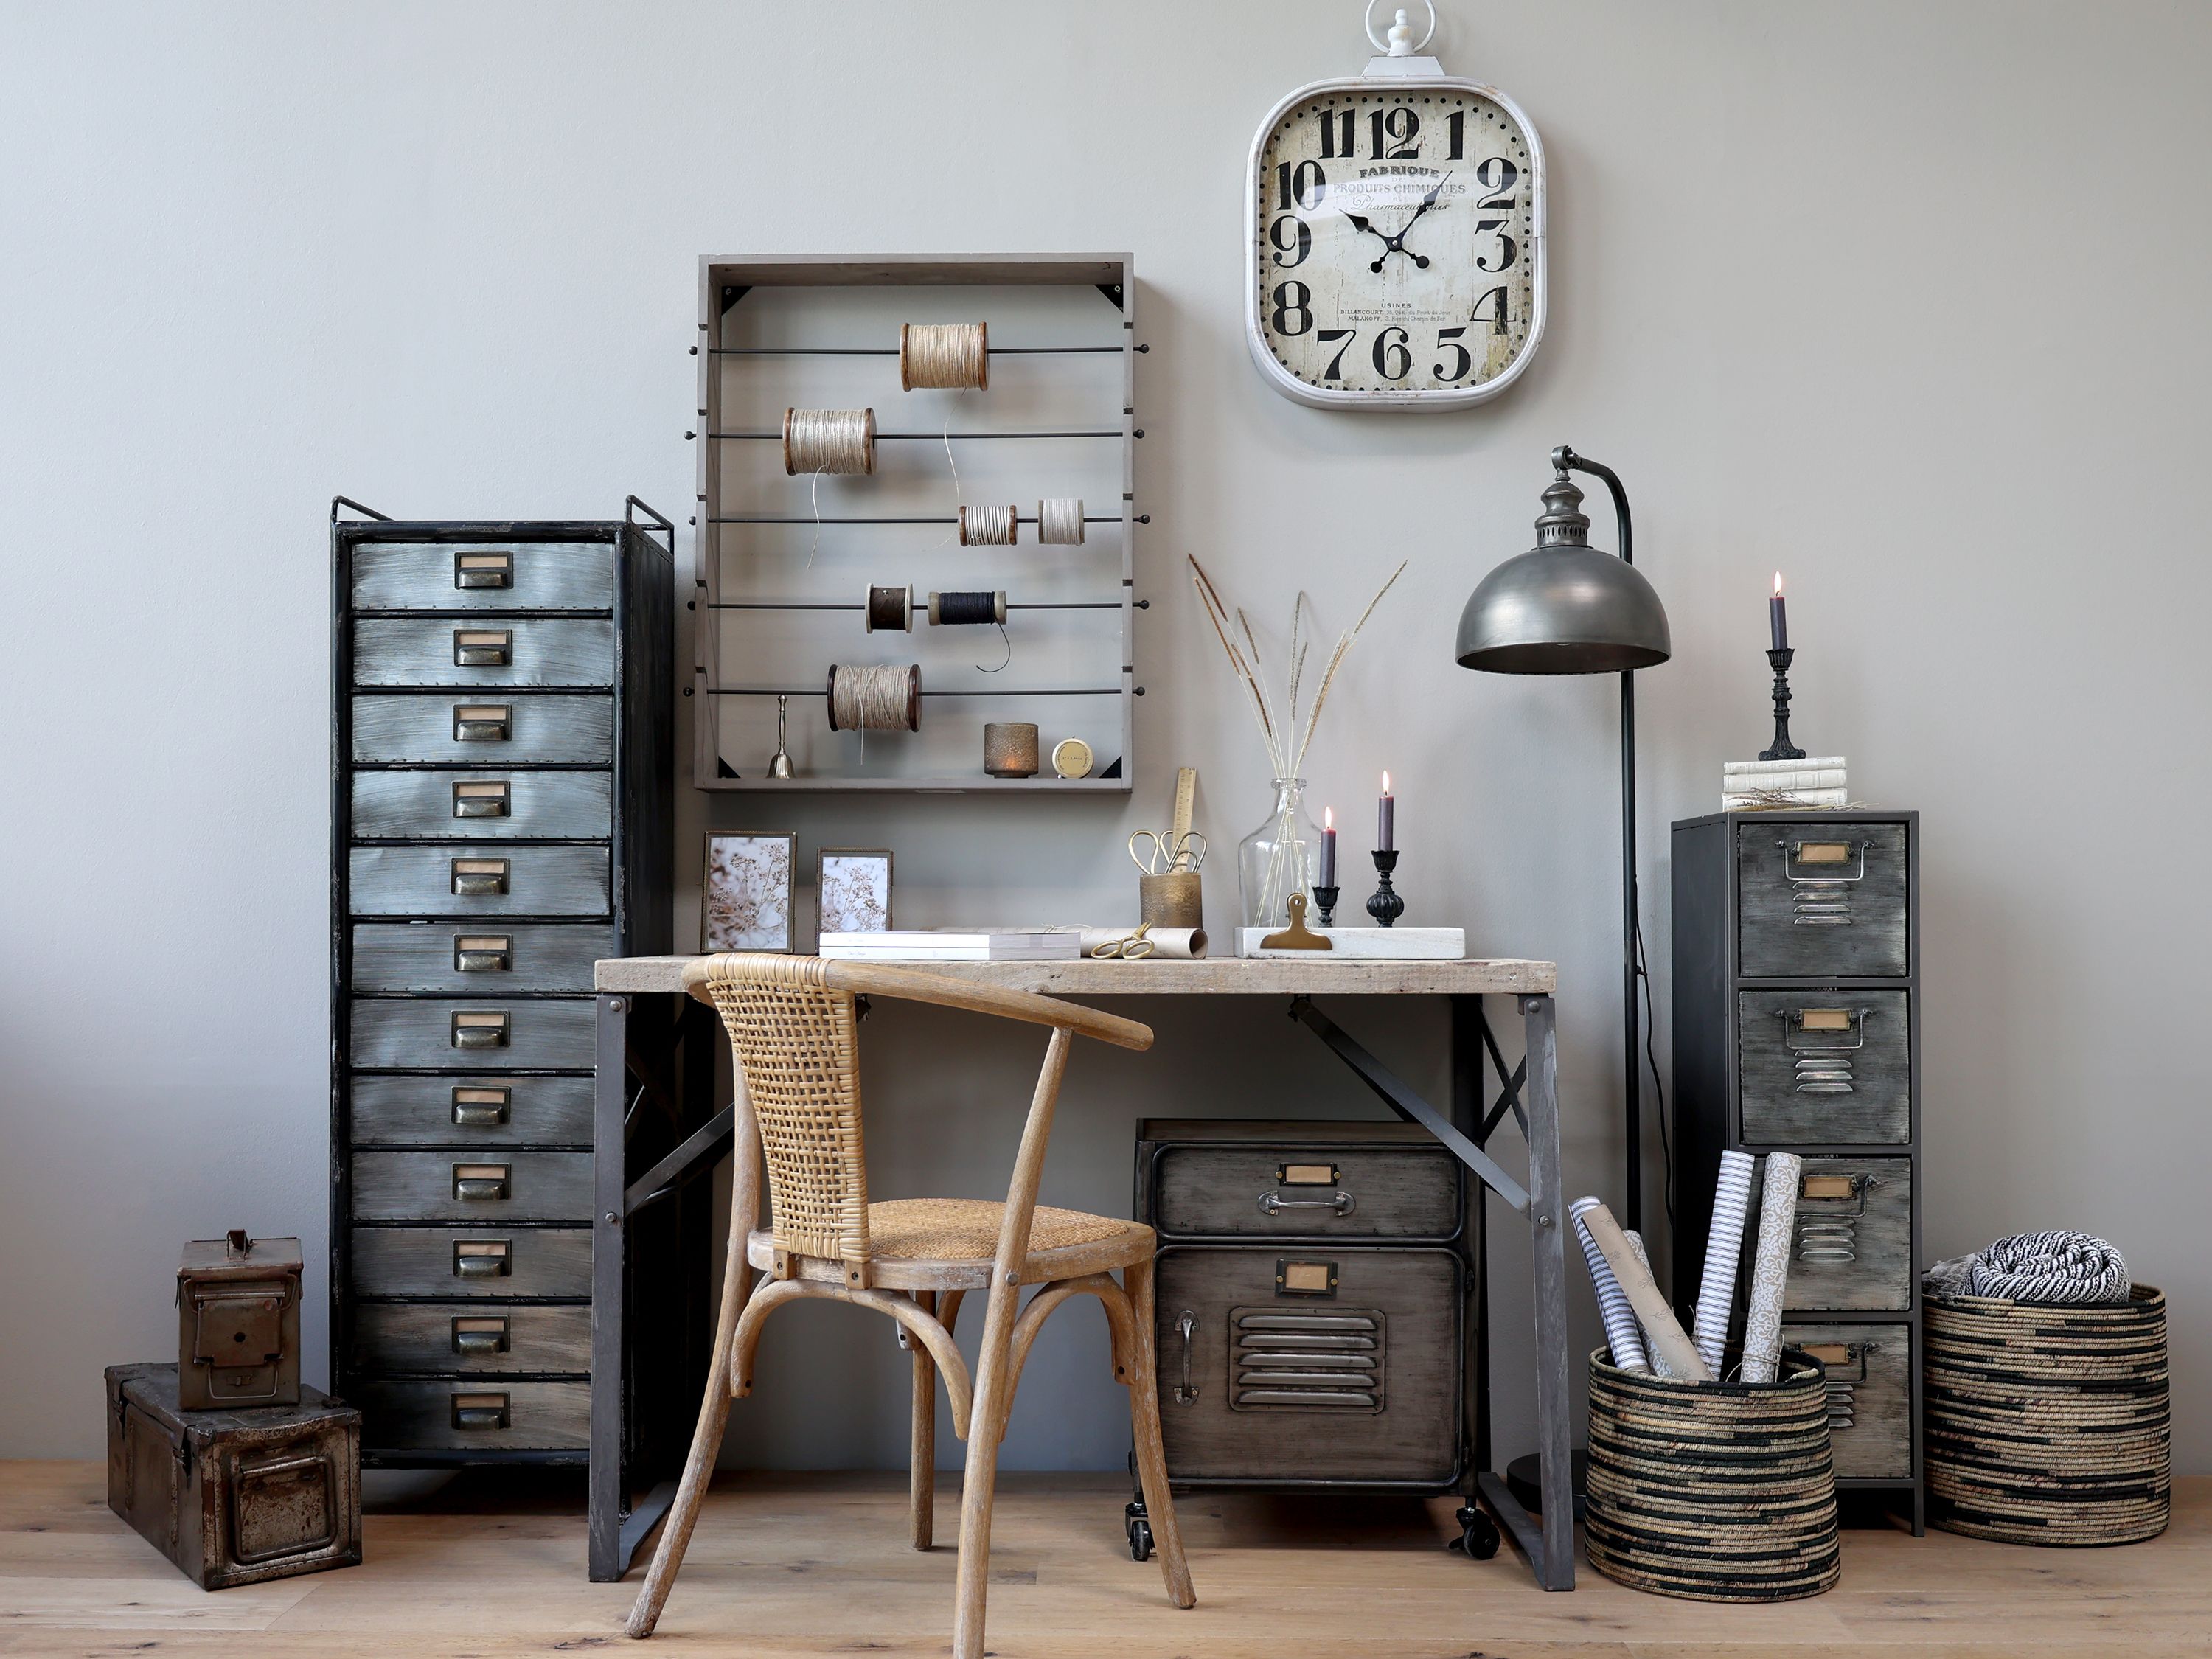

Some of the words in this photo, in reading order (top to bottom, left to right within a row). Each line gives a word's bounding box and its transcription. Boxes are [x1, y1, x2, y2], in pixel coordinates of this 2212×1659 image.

[1315, 108, 1356, 159] 11
[1366, 107, 1420, 160] 12
[1444, 110, 1464, 160] 1
[1276, 159, 1326, 212] 10
[1333, 184, 1391, 194] PRODUITS
[1359, 166, 1440, 178] FABRIQUE
[1476, 156, 1518, 209] 2
[1270, 215, 1312, 268] 9
[1475, 220, 1517, 273] 3
[1272, 280, 1314, 337] 8
[1469, 285, 1517, 335] 4
[1317, 329, 1357, 380] 7
[1372, 327, 1412, 381] 6
[1433, 327, 1472, 382] 5
